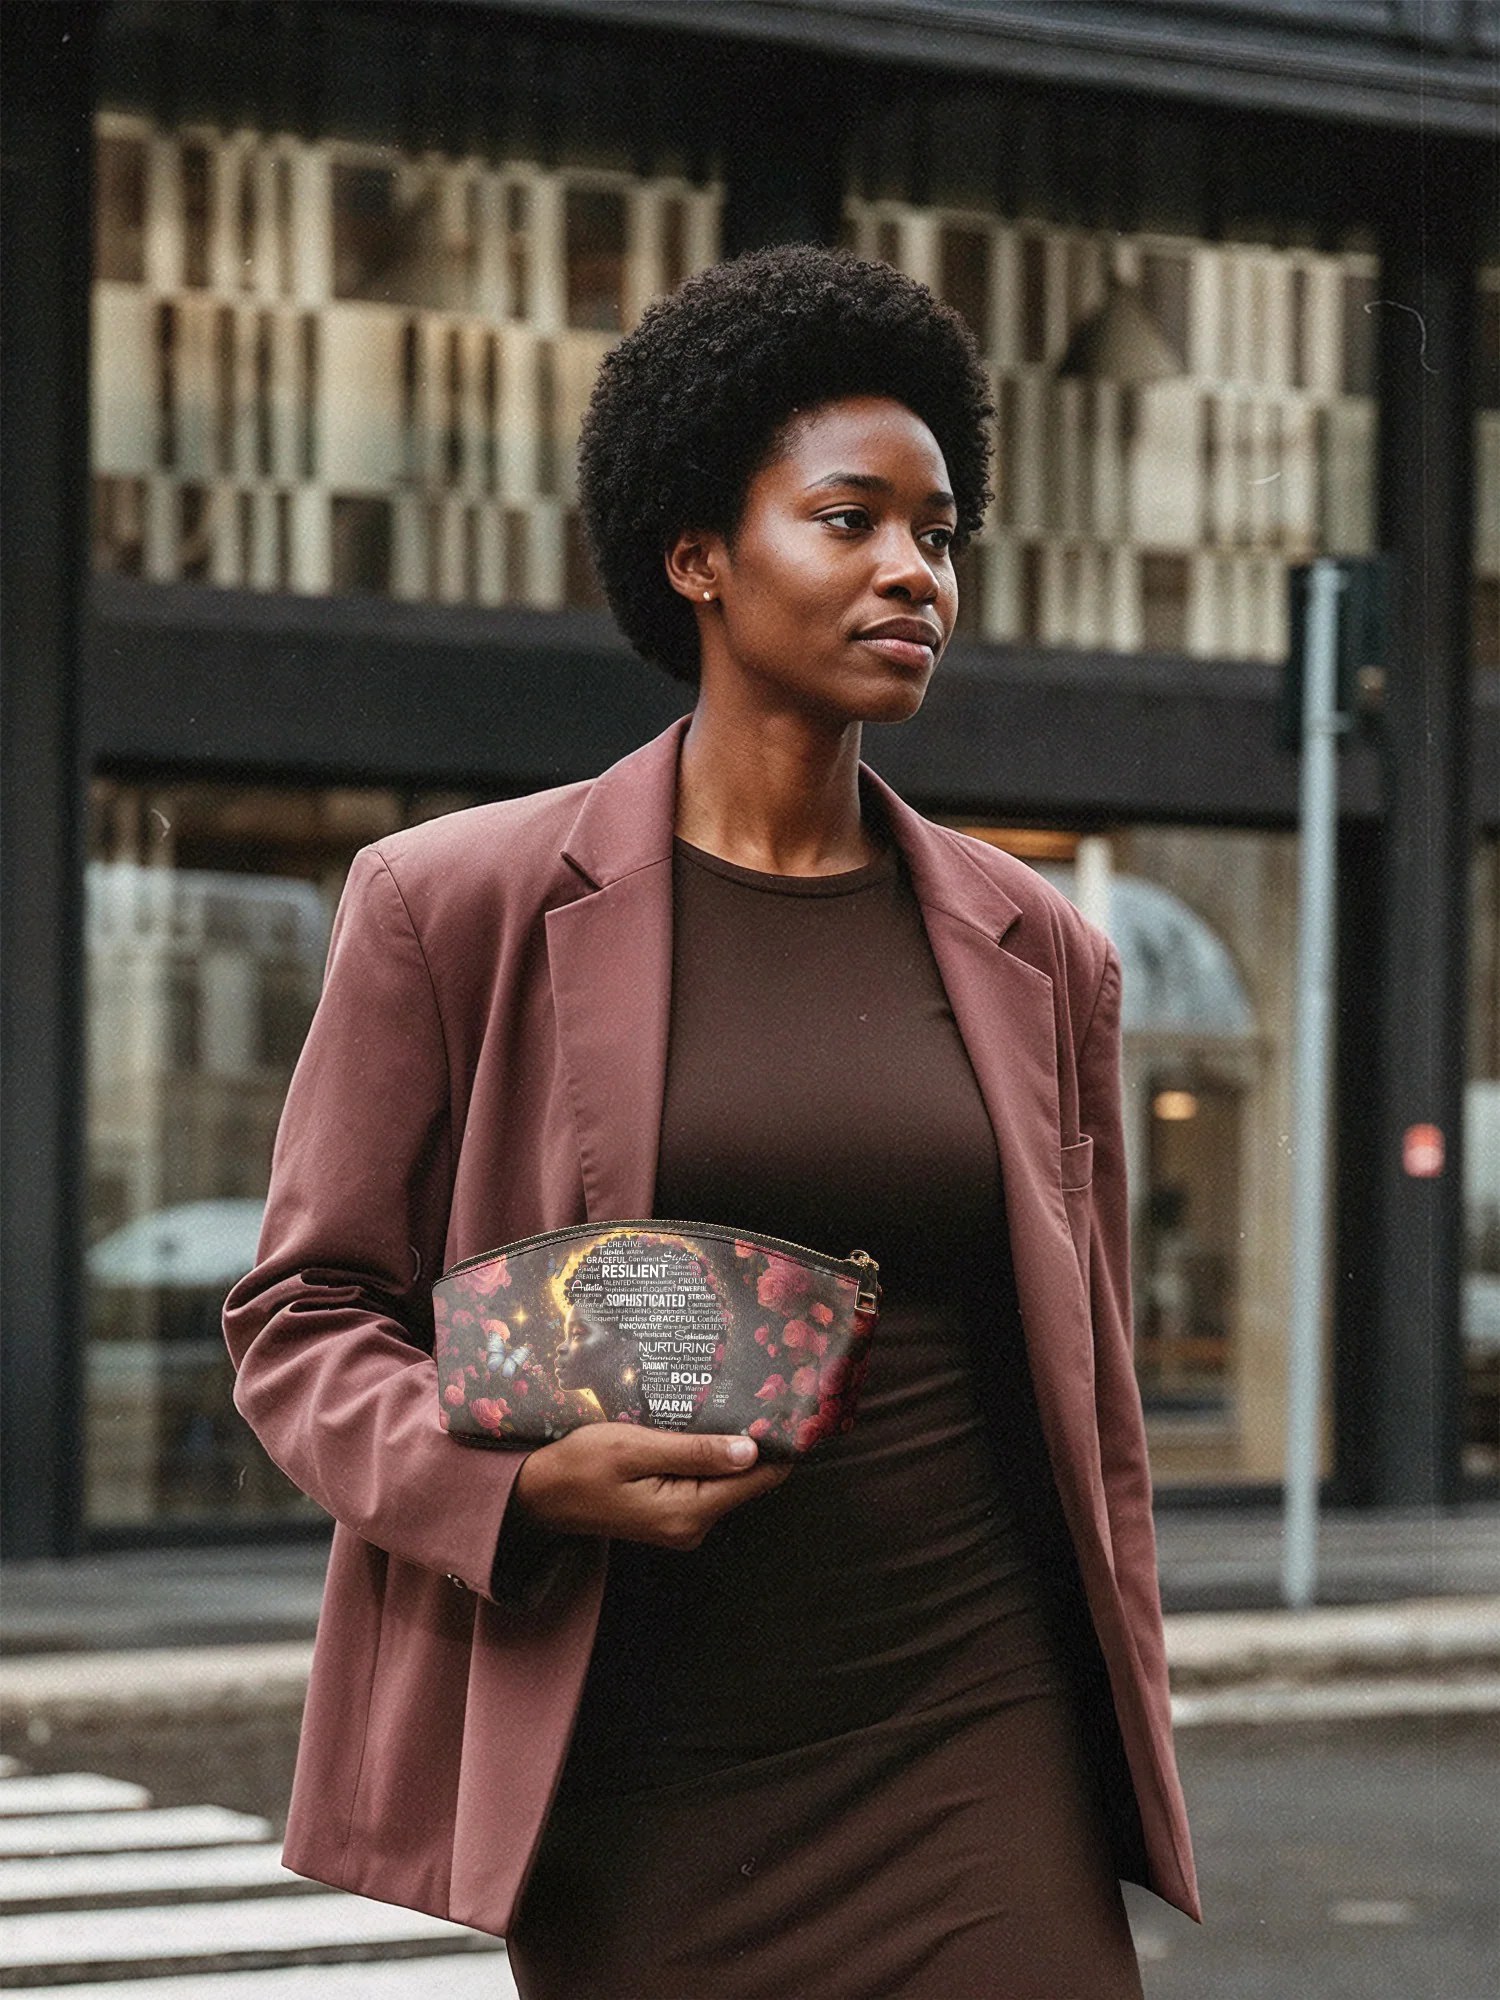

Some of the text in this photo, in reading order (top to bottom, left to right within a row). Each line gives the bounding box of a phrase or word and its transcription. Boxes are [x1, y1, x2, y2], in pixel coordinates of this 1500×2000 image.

[607, 1240, 642, 1248] CREATIVE
[596, 1245, 624, 1255] Talented
[586, 1256, 626, 1264] GRACEFUL
[660, 1251, 699, 1265] Stylish
[601, 1264, 668, 1278] RESILIENT
[571, 1279, 603, 1291] Artistic
[678, 1277, 706, 1285] PROUD
[604, 1286, 642, 1294] Sophisticated
[606, 1293, 685, 1308] SOPHISTICATED
[615, 1307, 651, 1315] NURTURING
[587, 1315, 619, 1323] Eloquent
[649, 1314, 696, 1323] GRACEFUL
[697, 1315, 728, 1323] Confident
[619, 1322, 662, 1330] INNOVATIVE
[692, 1323, 728, 1331] RESILIENT
[632, 1331, 672, 1339] Sophisticated
[638, 1341, 716, 1354] NURTURING
[642, 1361, 712, 1371] RADIANT NURTURING
[642, 1375, 670, 1383] Creative
[670, 1371, 712, 1385] BOLD
[641, 1383, 683, 1392] RESILIENT
[644, 1391, 698, 1401] Compassionate
[648, 1399, 693, 1412] WARM
